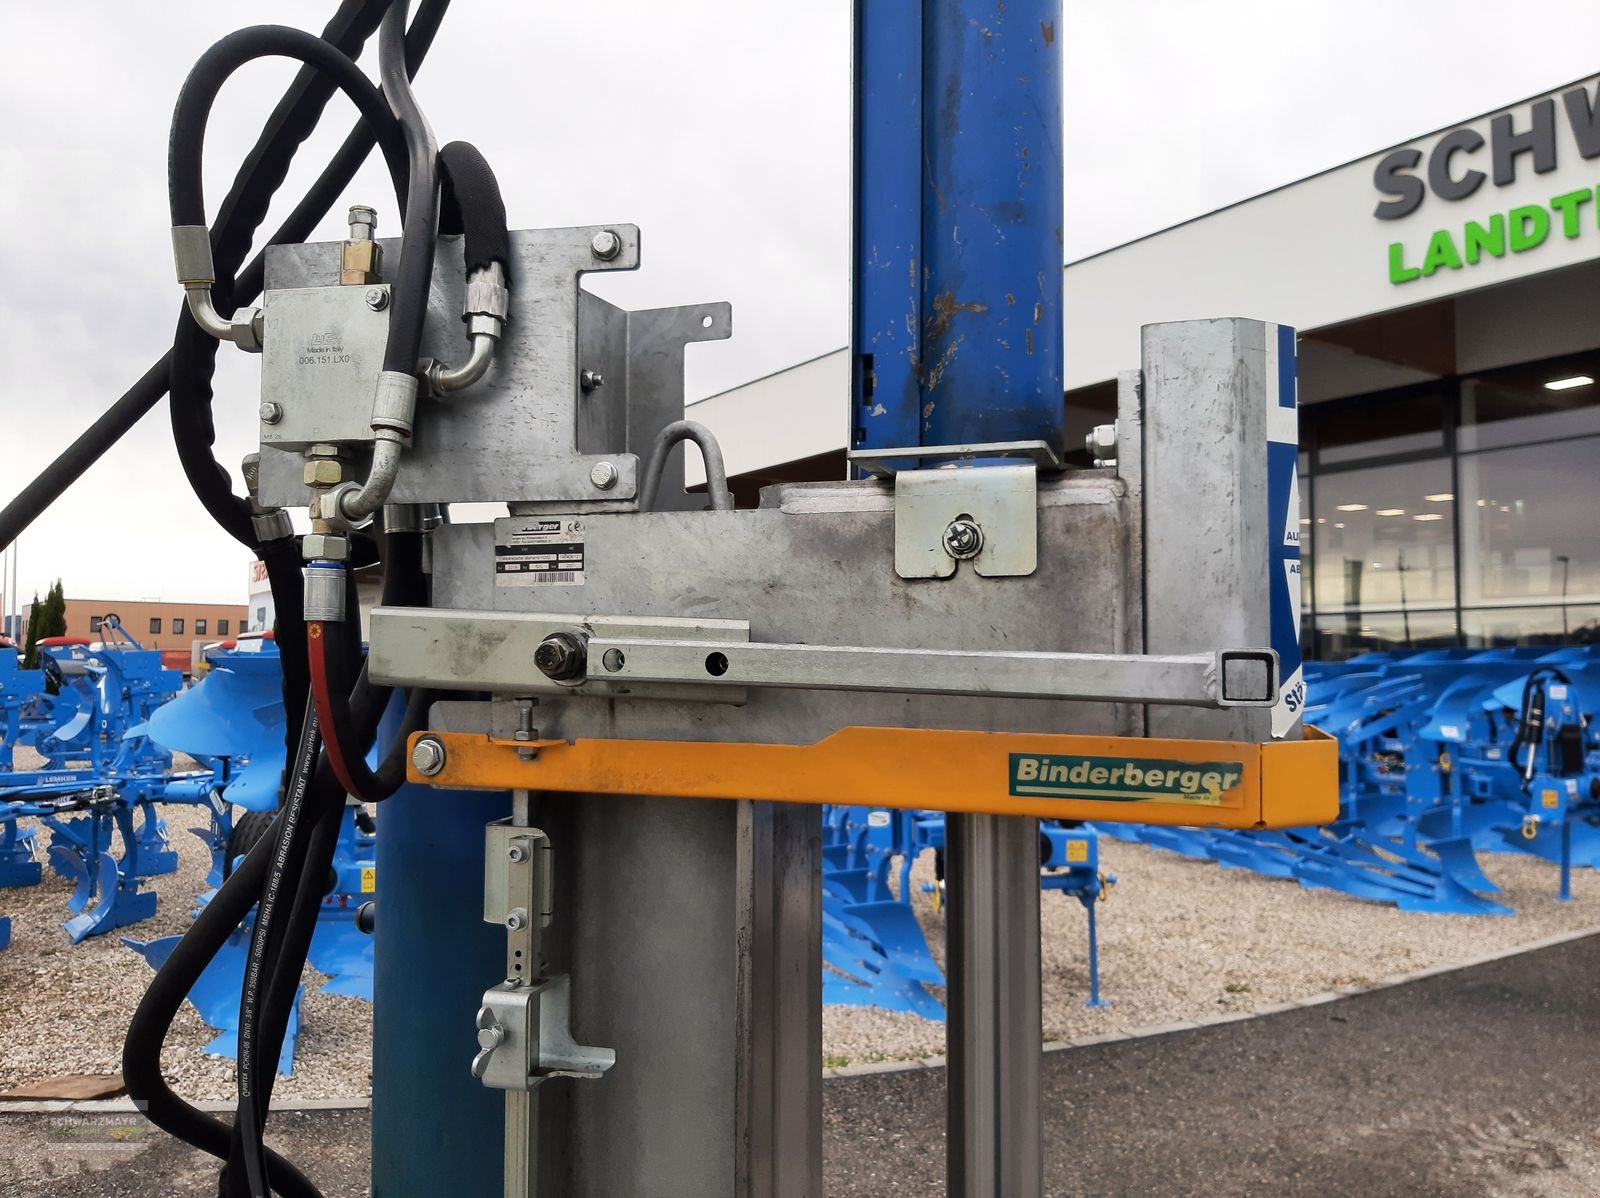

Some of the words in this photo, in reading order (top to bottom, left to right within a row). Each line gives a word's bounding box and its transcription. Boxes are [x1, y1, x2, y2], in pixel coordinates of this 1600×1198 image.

[1388, 183, 1600, 285] LANDT
[306, 346, 325, 354] Made
[331, 345, 344, 354] Italy
[1286, 531, 1300, 541] AU
[1016, 758, 1239, 793] Binderberger
[255, 928, 267, 958] 5000PSI
[261, 903, 273, 926] MSHA
[277, 824, 295, 869] ABRASION
